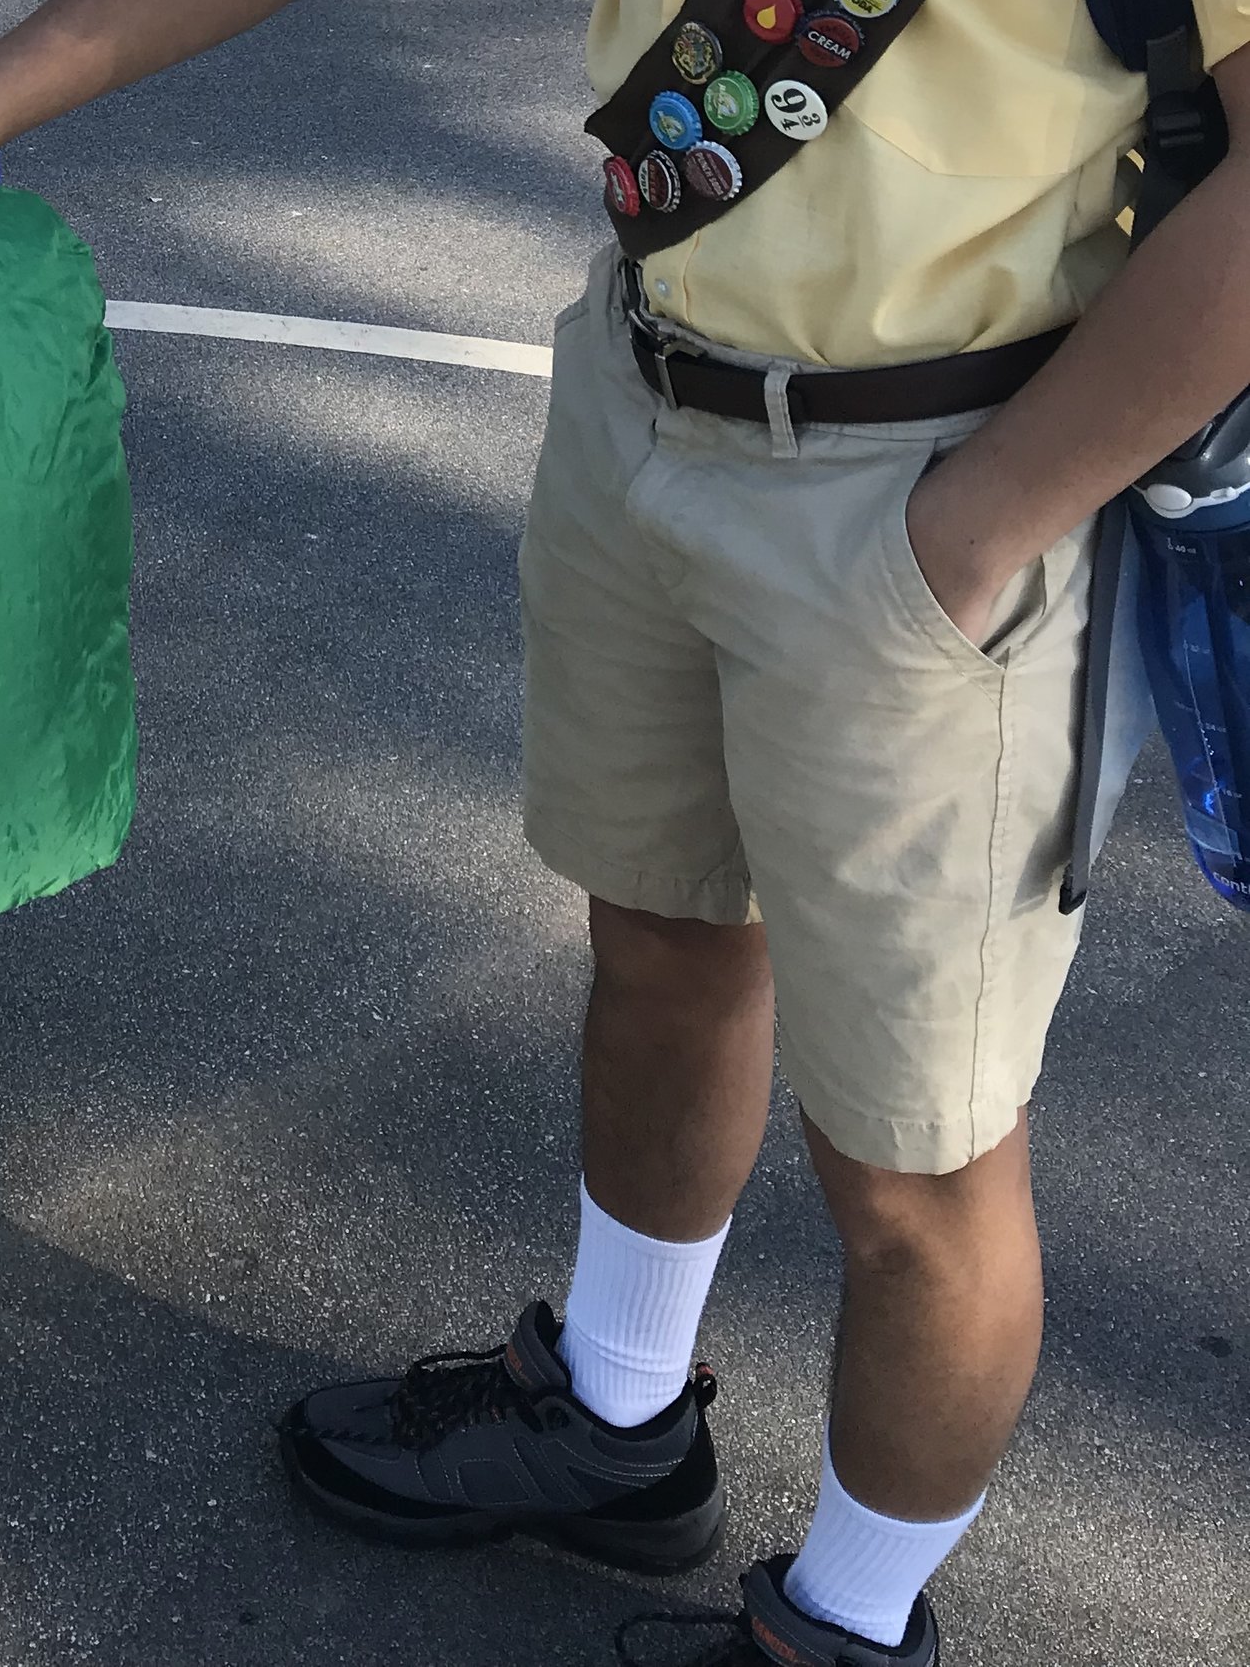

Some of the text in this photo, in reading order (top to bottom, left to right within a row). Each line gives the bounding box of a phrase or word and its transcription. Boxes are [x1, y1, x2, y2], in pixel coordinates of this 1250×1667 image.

[807, 30, 852, 60] CREAM
[771, 88, 808, 114] 9
[695, 152, 714, 177] PUNCH
